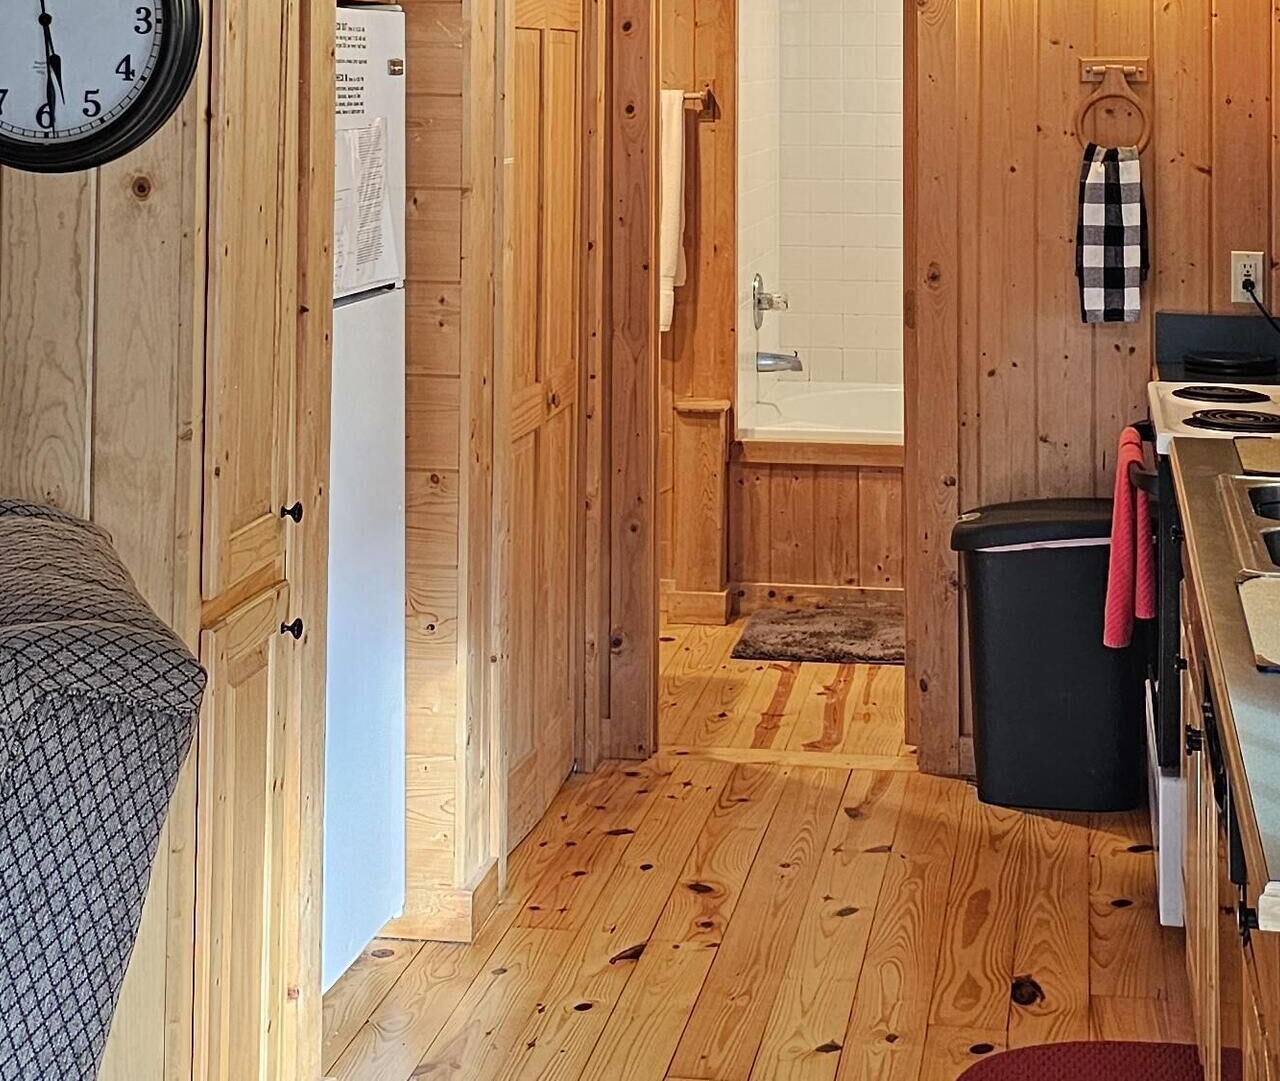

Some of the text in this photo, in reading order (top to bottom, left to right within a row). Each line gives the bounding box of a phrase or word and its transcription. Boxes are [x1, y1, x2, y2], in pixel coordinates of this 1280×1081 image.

[133, 6, 153, 35] 3
[115, 54, 136, 82] 4
[35, 101, 55, 129] 6
[82, 88, 102, 118] 5
